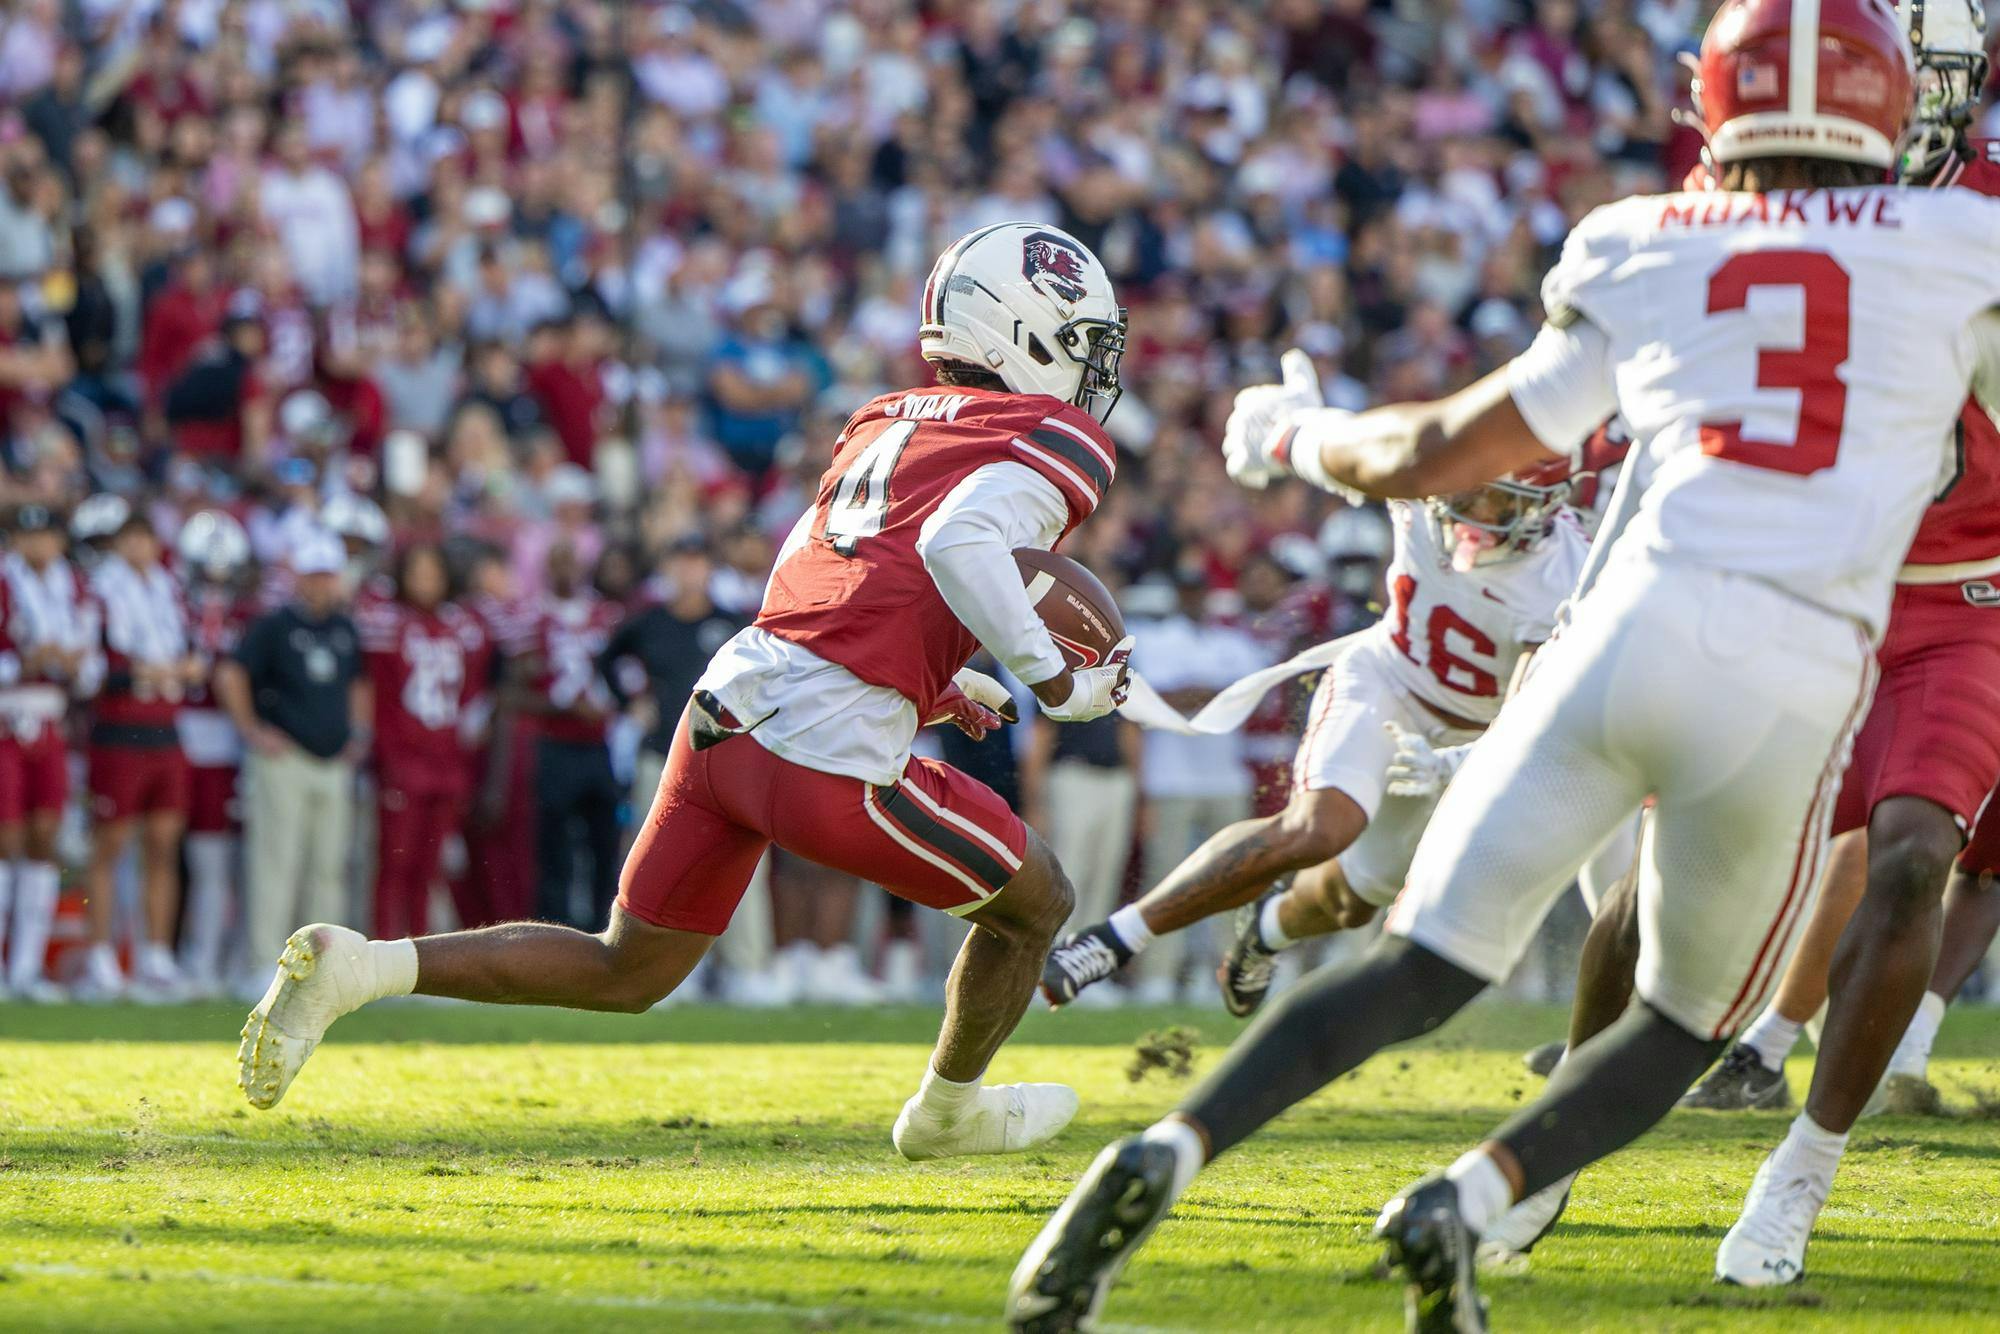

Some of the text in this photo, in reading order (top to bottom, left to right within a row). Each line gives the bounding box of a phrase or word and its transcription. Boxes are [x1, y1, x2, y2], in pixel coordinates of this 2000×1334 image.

[1698, 247, 1851, 478] 3
[823, 419, 920, 557] 4
[1391, 574, 1499, 698] 16
